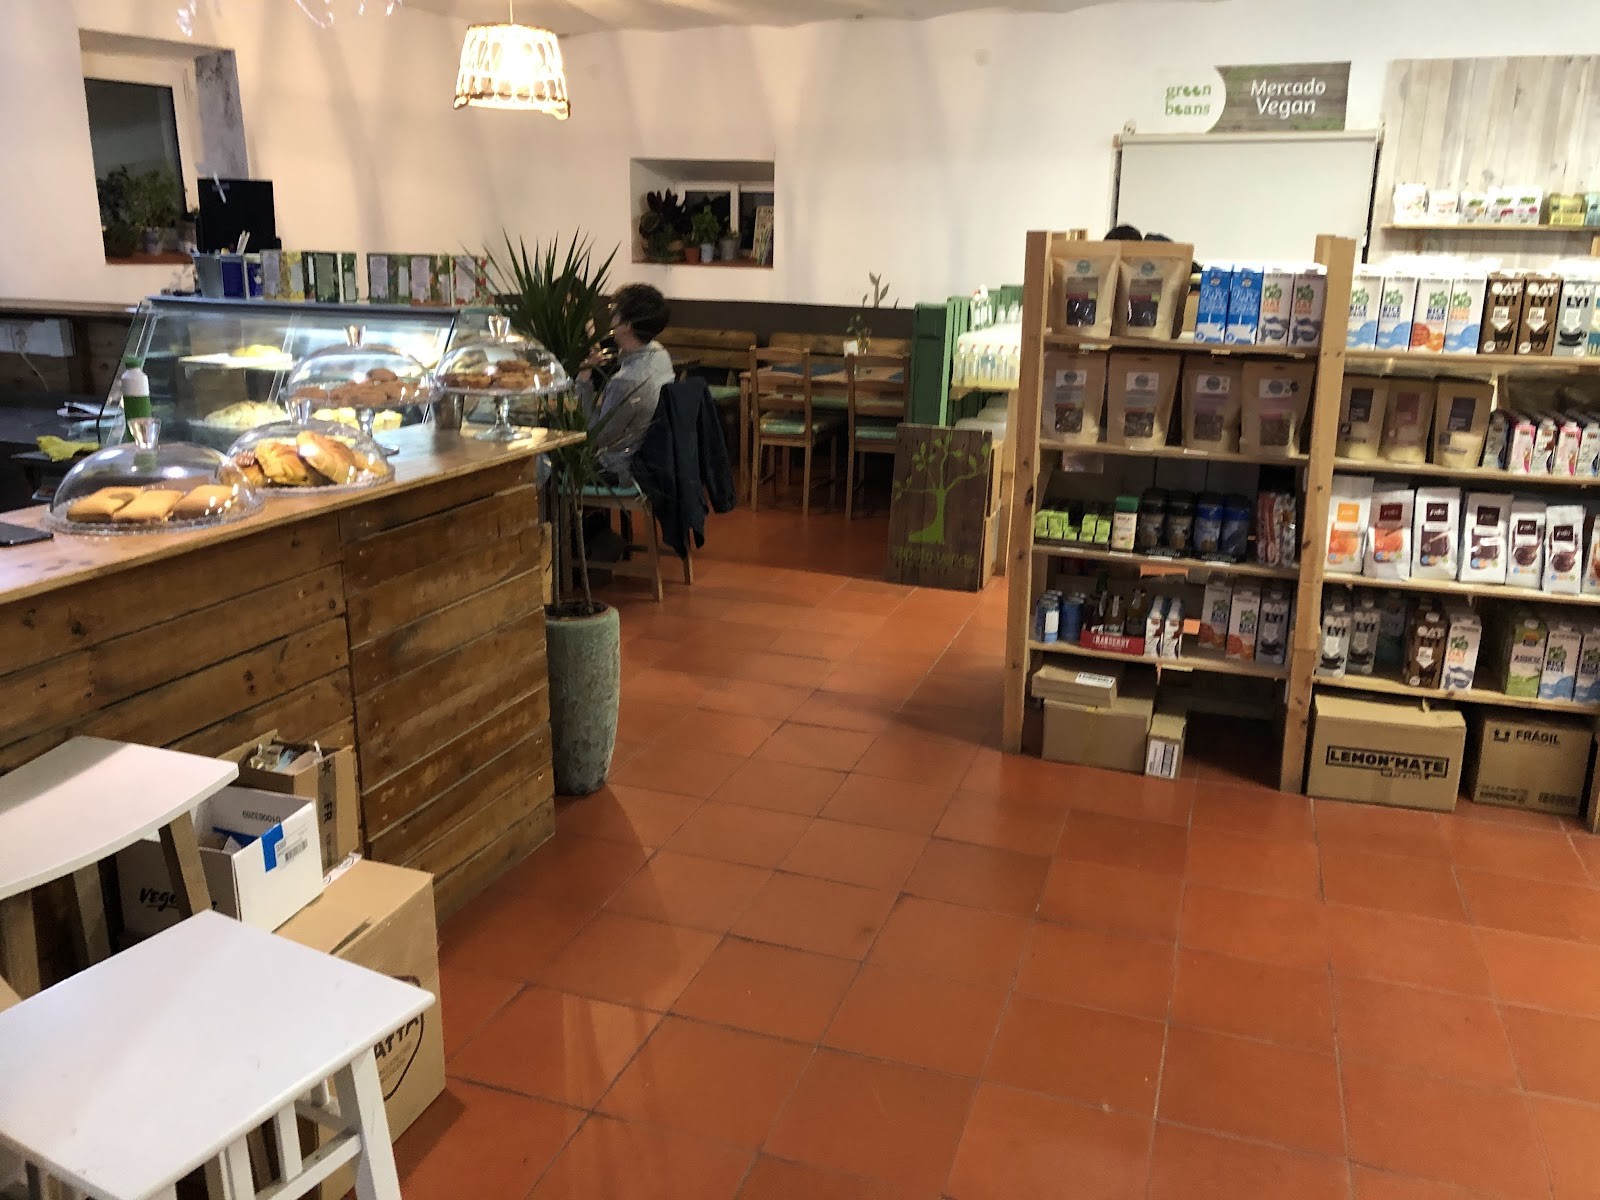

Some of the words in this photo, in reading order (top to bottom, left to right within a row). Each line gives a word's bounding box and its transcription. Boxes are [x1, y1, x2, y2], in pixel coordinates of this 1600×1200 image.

[1165, 83, 1212, 98] green
[1250, 76, 1326, 97] Mercado
[1164, 96, 1211, 116] beans
[1256, 97, 1316, 120] Vegan
[1492, 282, 1522, 296] OAT
[1527, 282, 1558, 297] OAT
[1564, 283, 1595, 297] OAT
[1427, 307, 1446, 315] RICE
[1329, 750, 1445, 773] LEMON'MATE
